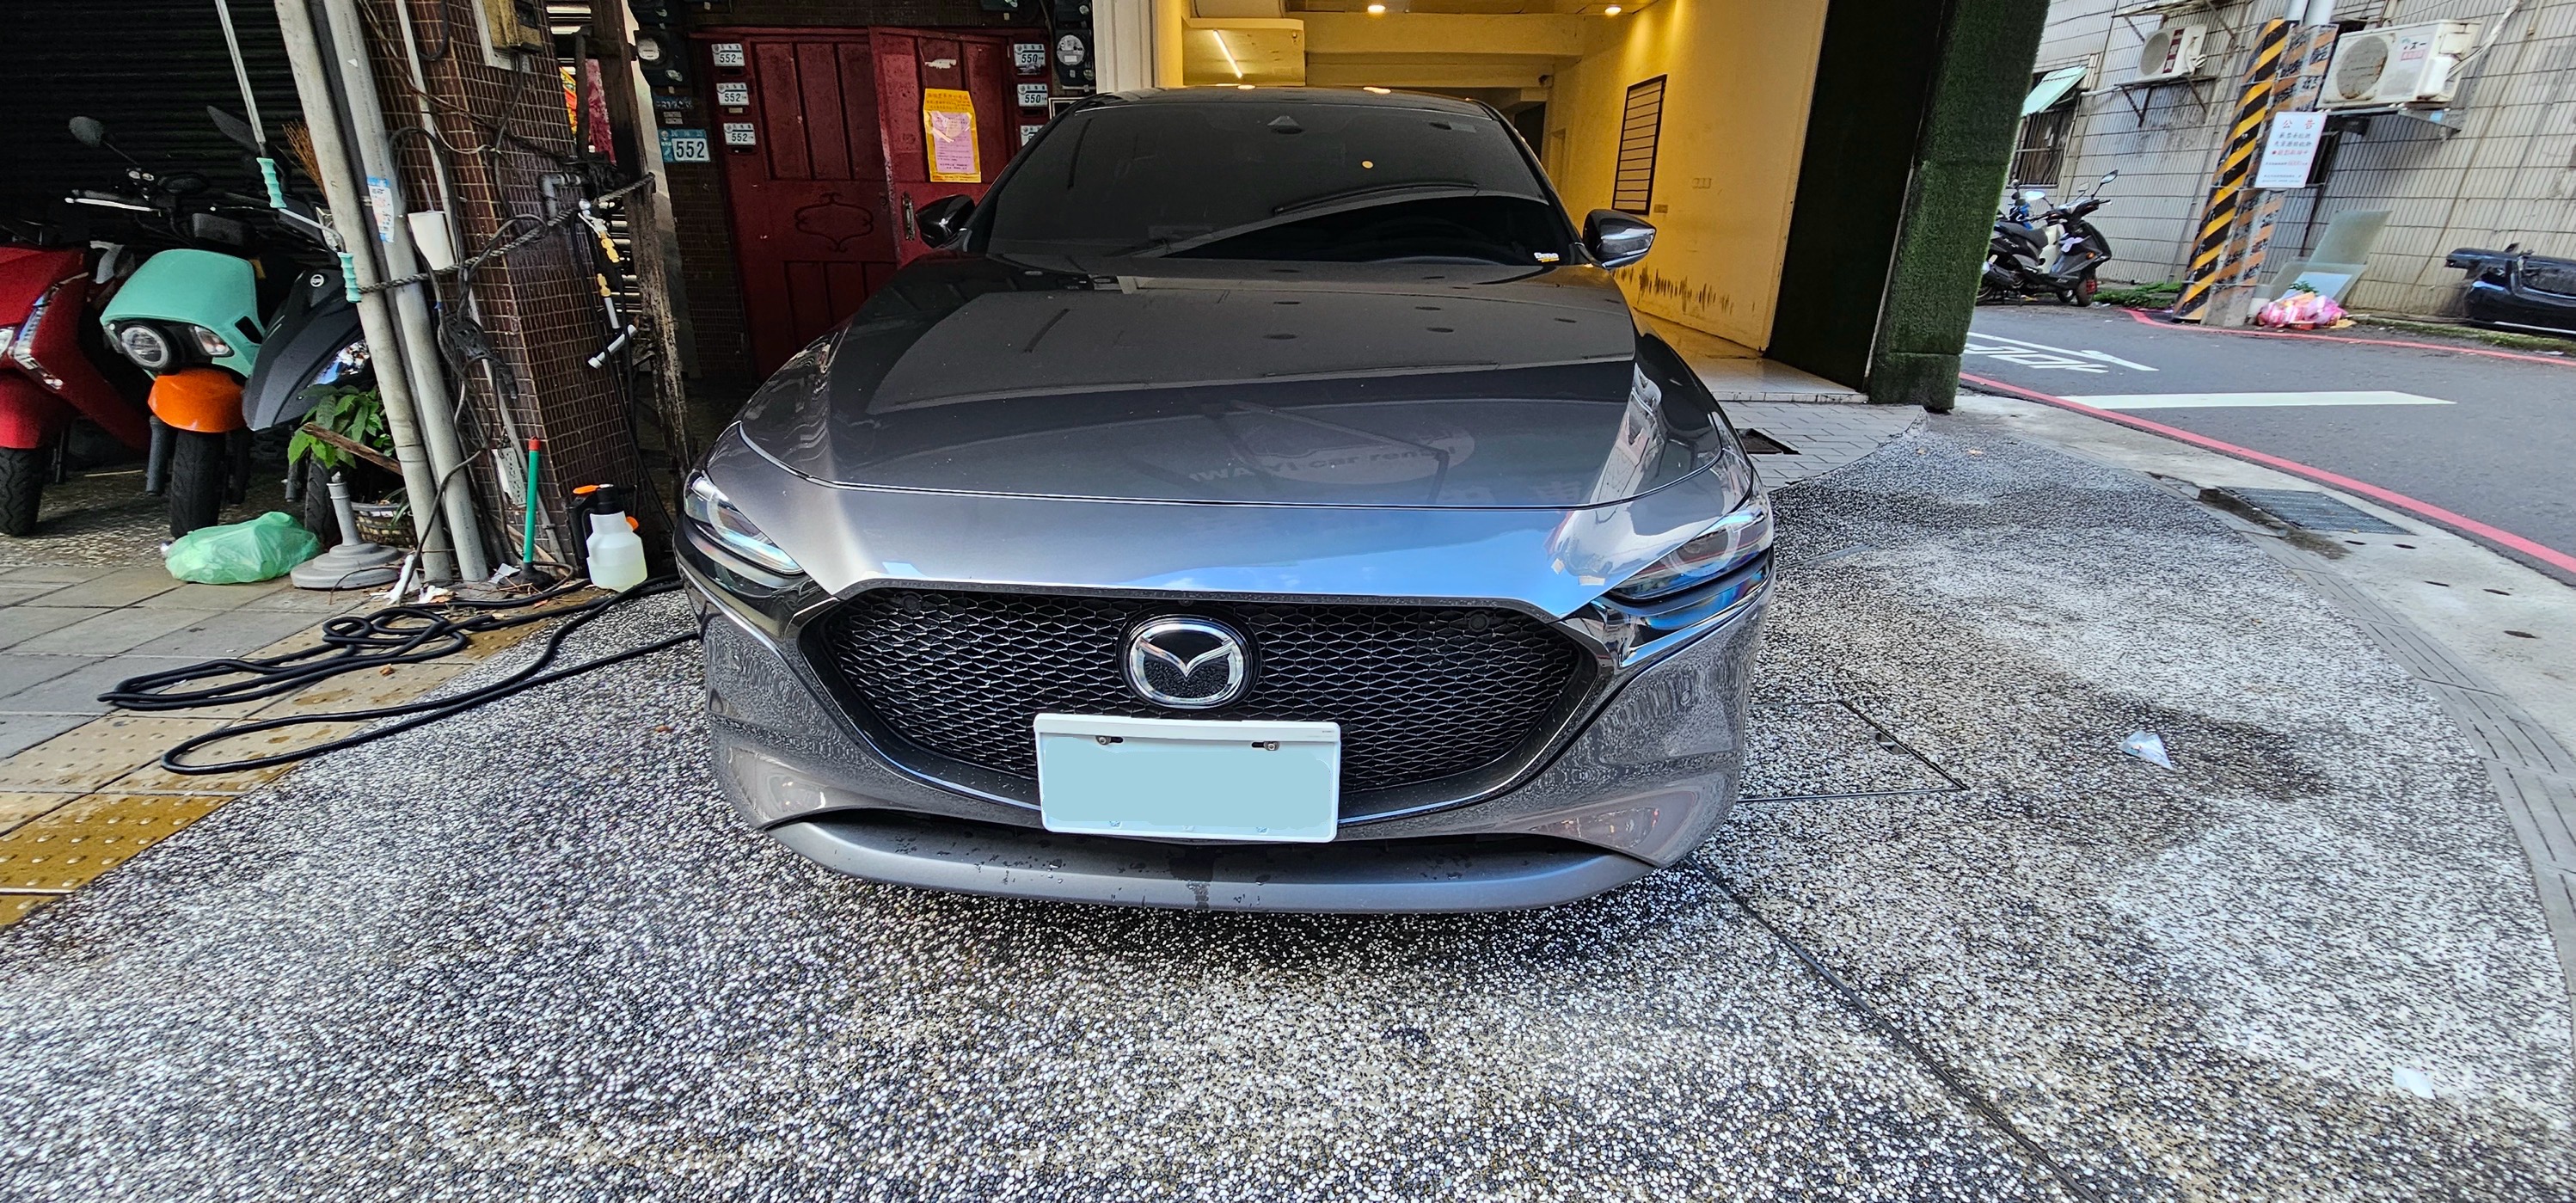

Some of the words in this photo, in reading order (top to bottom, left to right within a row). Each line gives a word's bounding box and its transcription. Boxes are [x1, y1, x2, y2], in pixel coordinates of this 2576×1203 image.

[720, 53, 736, 63] 552
[1021, 53, 1038, 64] 550
[724, 93, 741, 102] 552
[1025, 94, 1041, 103] 550
[731, 133, 748, 142] 552
[676, 140, 705, 158] 552
